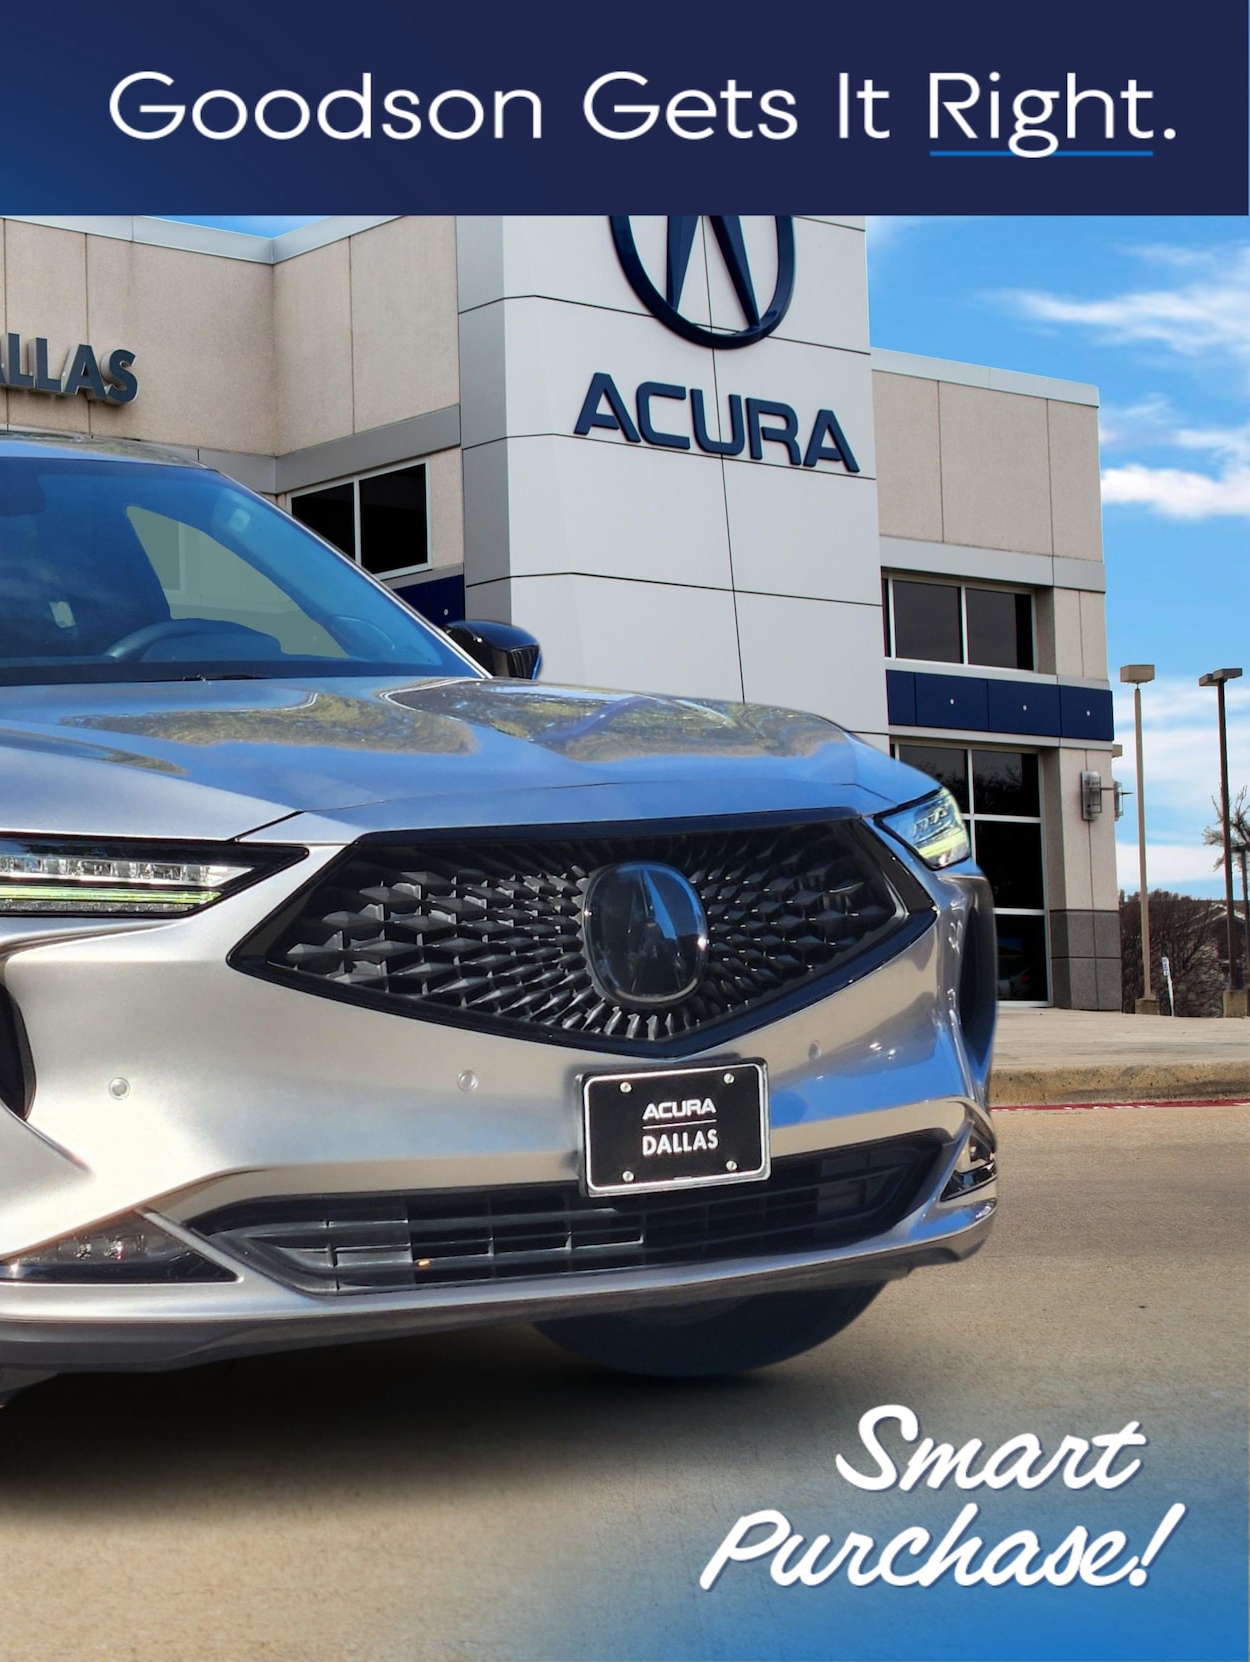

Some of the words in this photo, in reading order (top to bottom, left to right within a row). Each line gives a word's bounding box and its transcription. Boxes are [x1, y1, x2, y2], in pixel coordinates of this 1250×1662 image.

[573, 372, 860, 473] ACURA
[642, 1097, 717, 1120] ACURA
[642, 1128, 719, 1156] DALLAS
